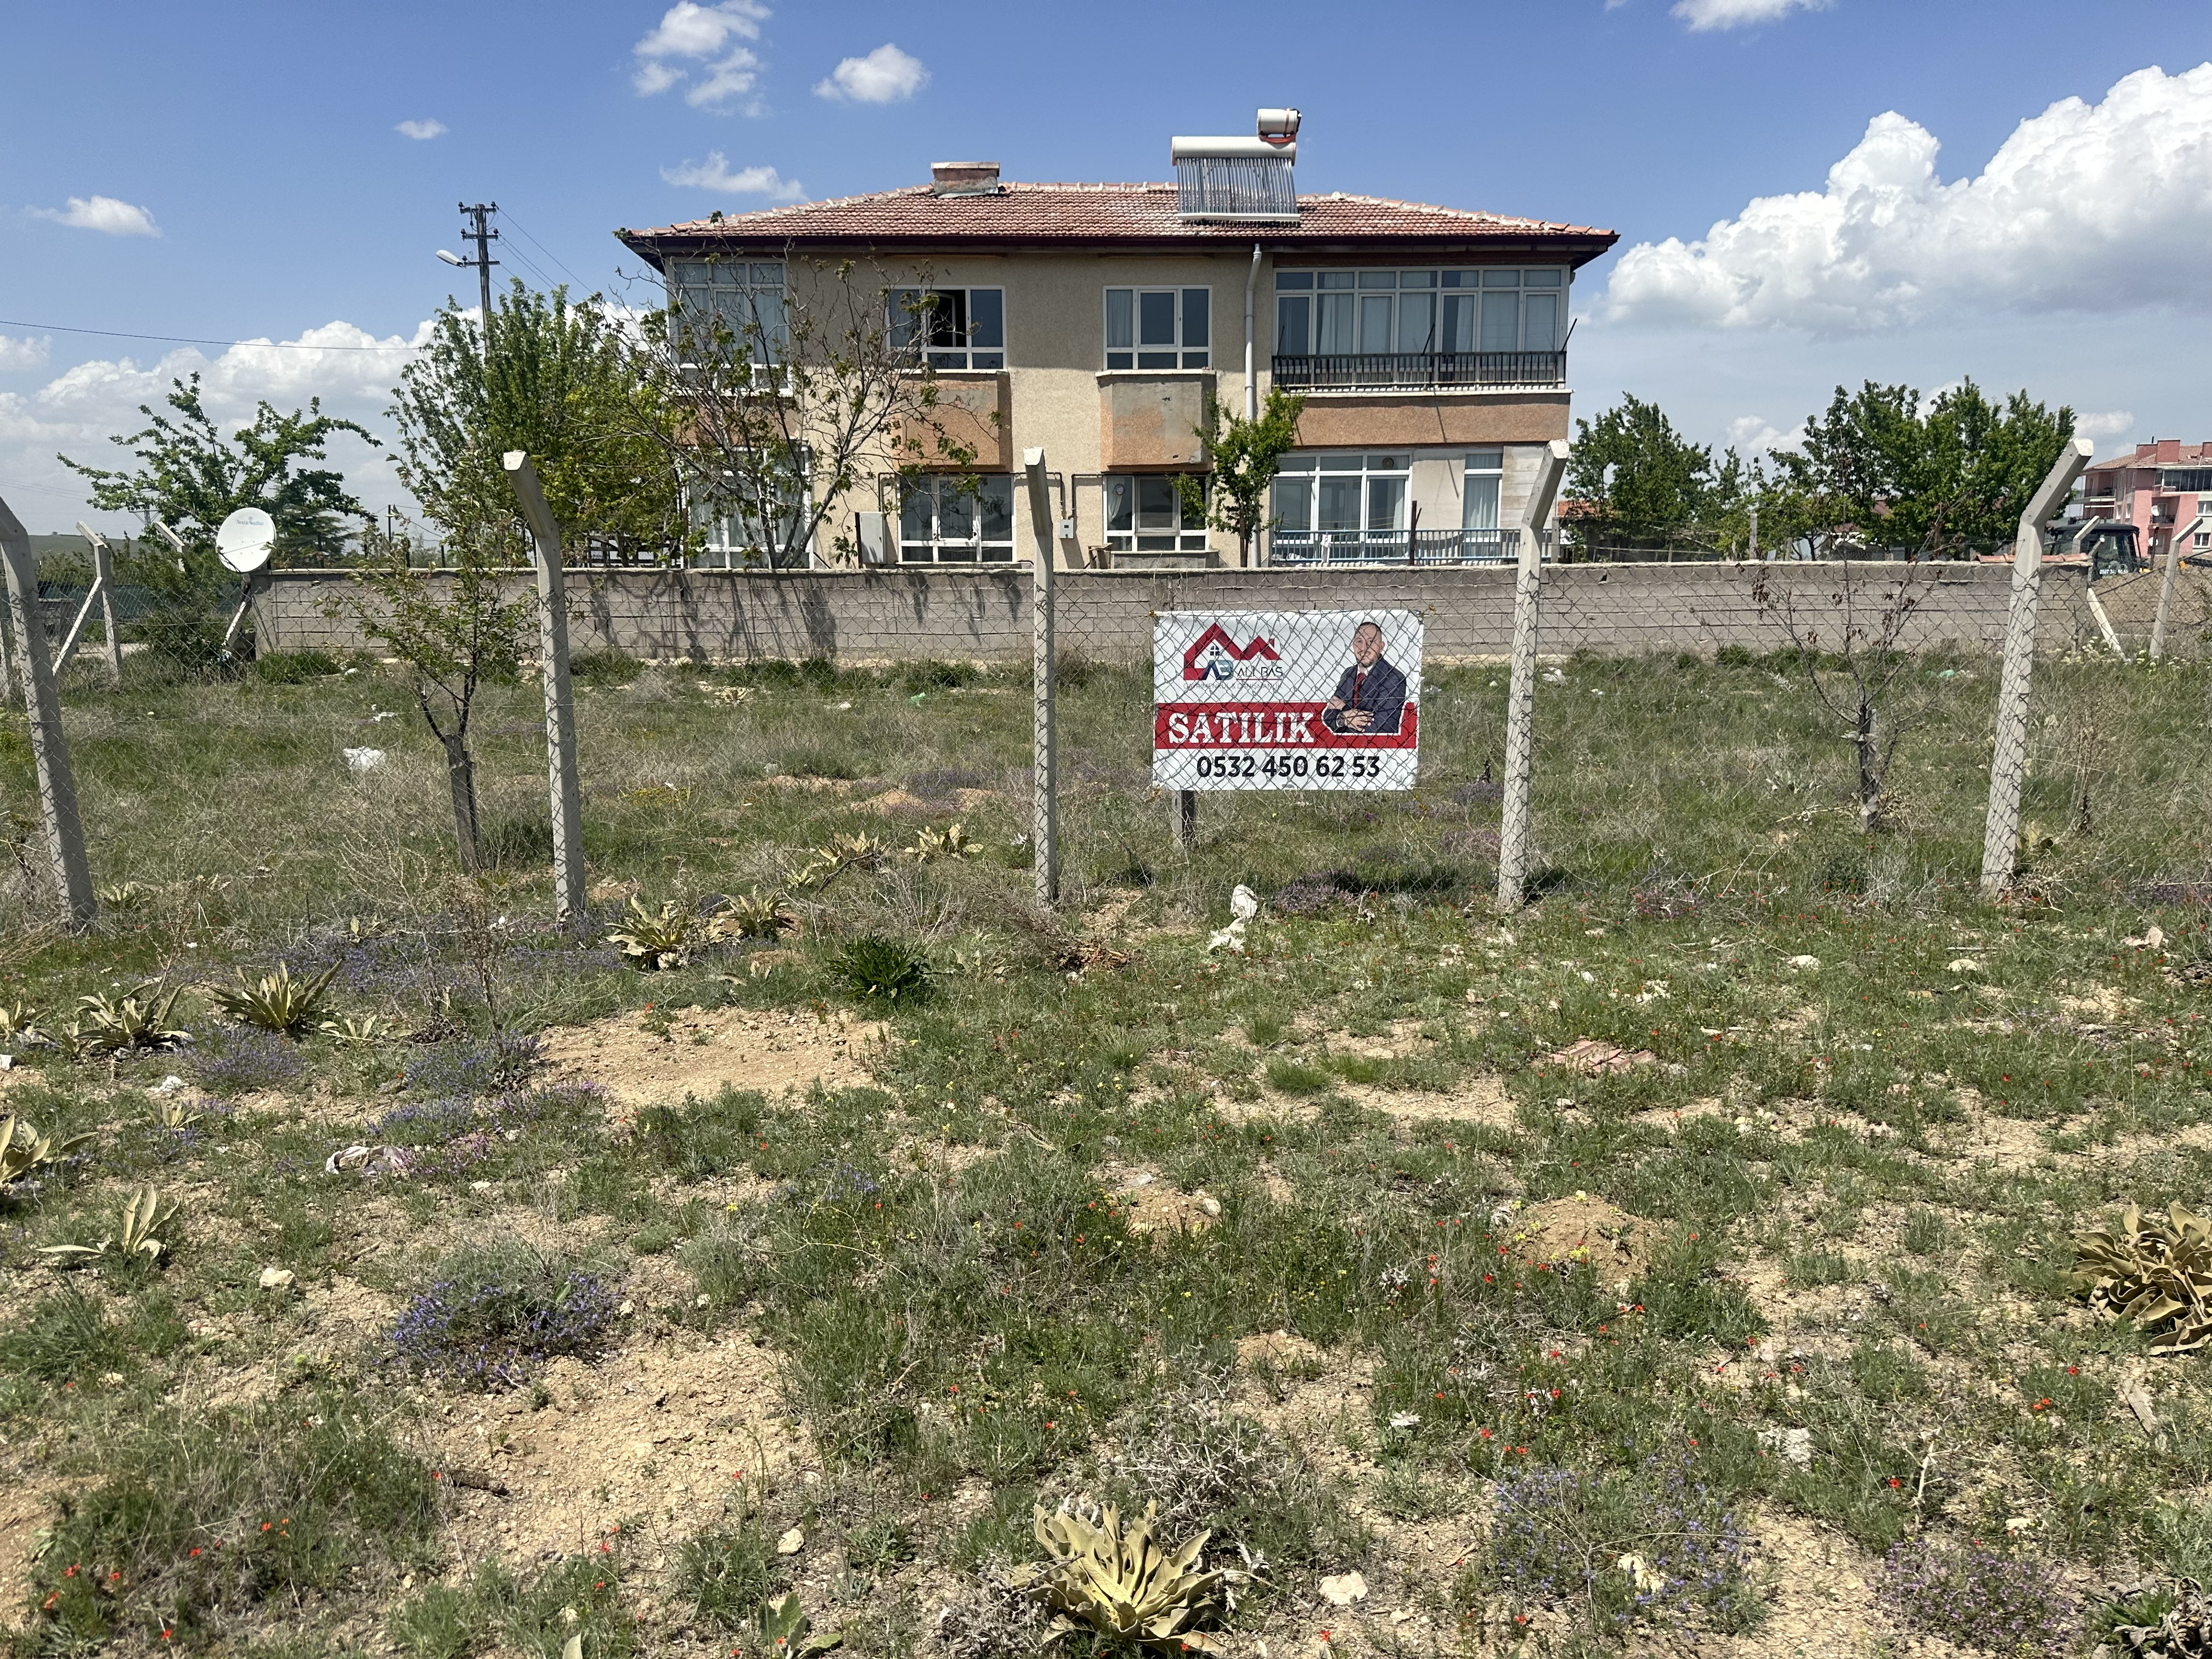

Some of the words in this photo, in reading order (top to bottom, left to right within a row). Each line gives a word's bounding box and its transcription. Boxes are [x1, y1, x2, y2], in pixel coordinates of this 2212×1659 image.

[1168, 712, 1314, 744] SATILIK
[1197, 755, 1255, 777] 0532
[1262, 755, 1308, 777] 450
[1316, 755, 1344, 777] 62
[1352, 756, 1380, 777] 53
